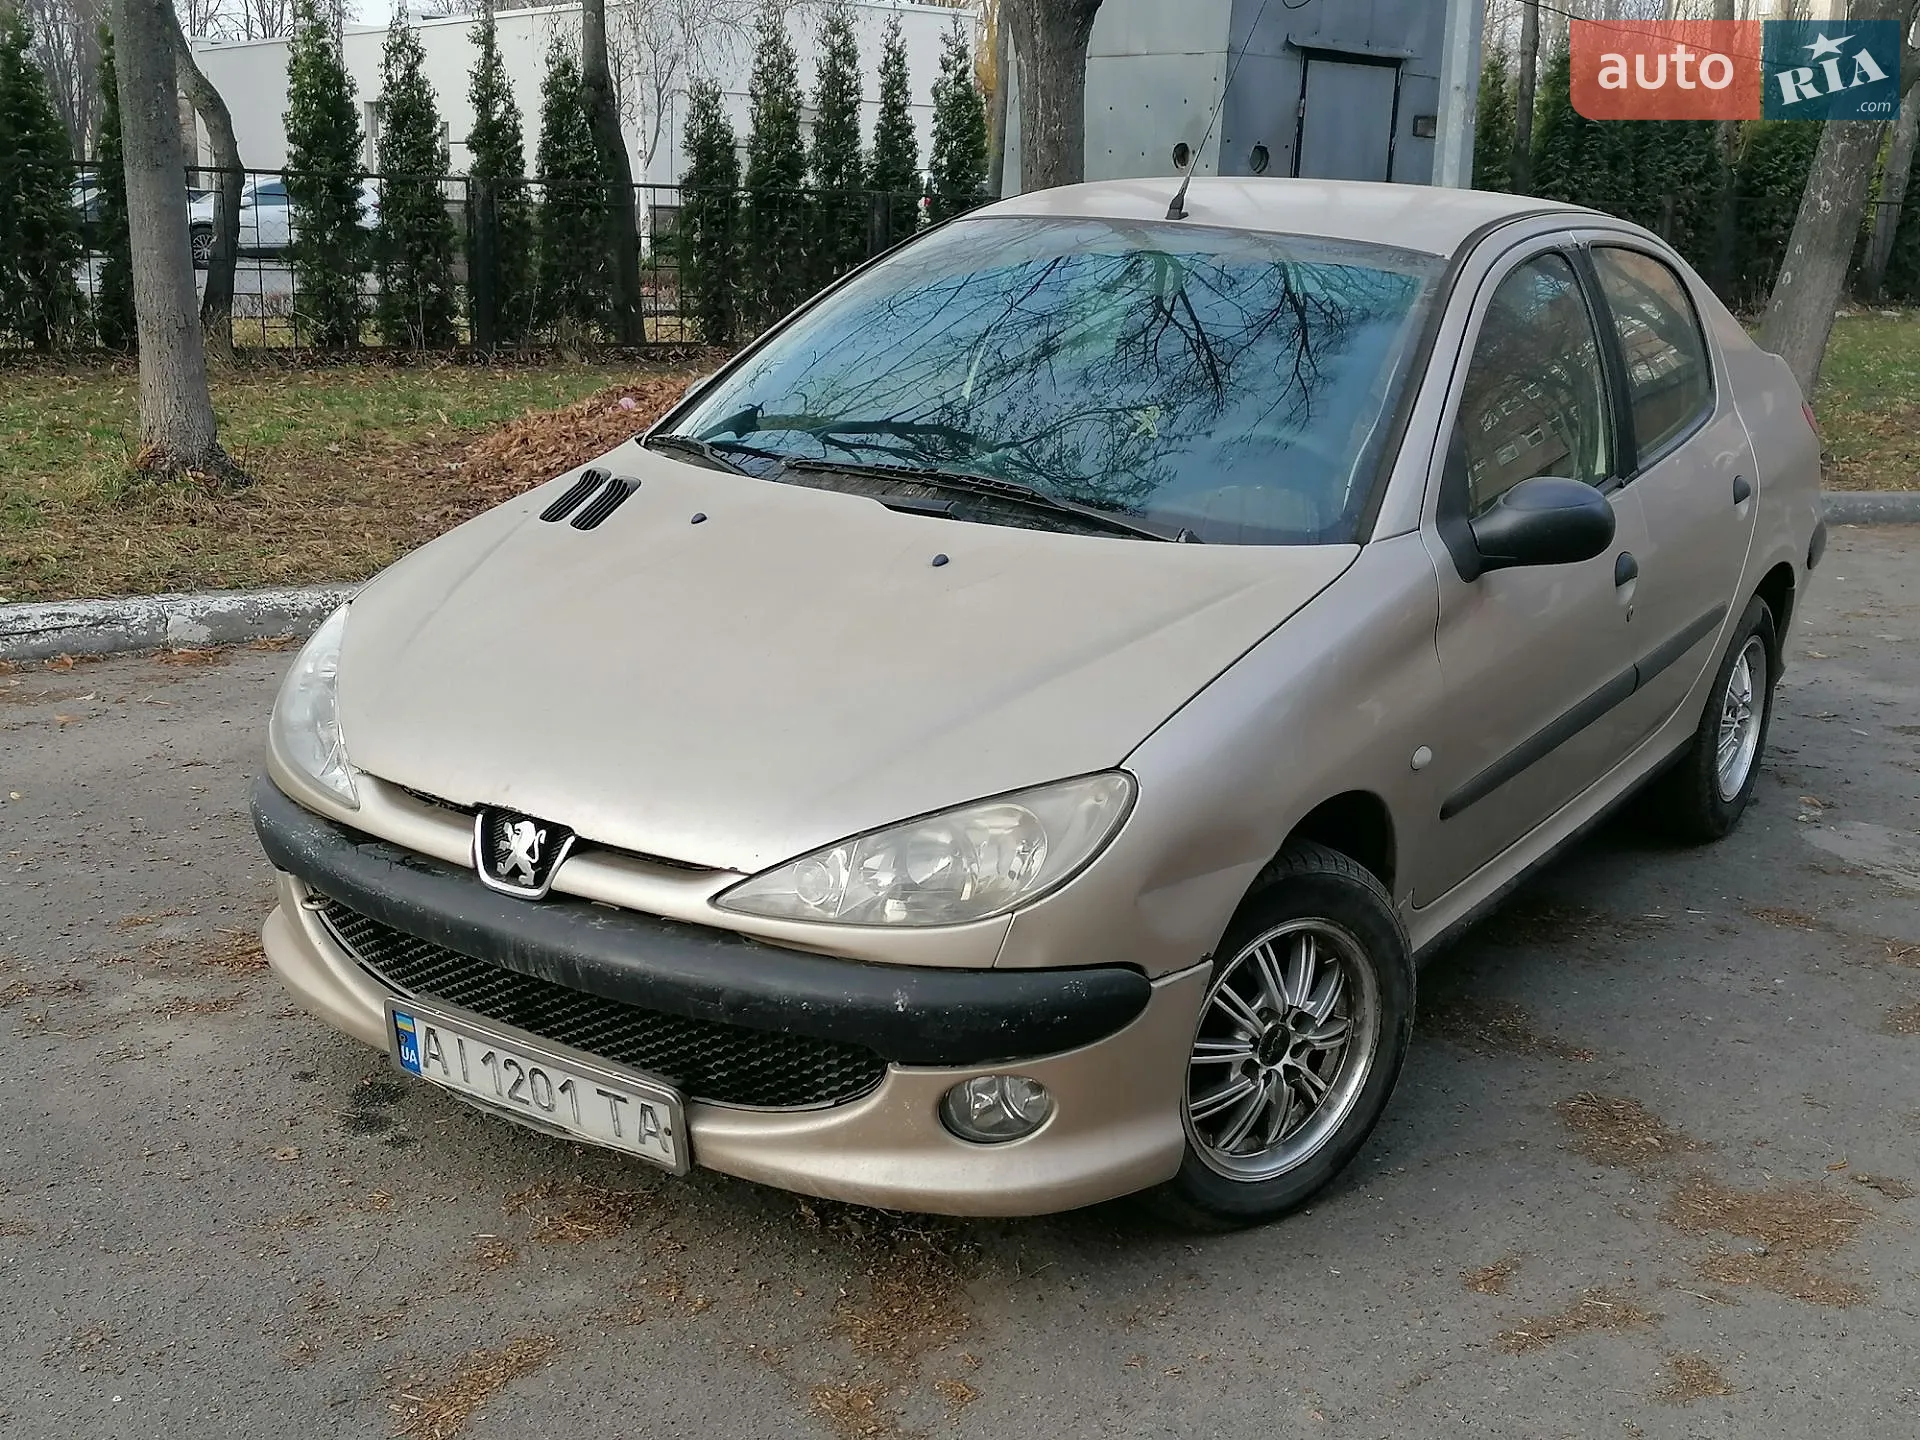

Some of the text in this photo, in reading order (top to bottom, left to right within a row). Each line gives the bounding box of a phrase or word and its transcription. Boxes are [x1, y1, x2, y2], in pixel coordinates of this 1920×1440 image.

[401, 1045, 418, 1066] UA
[423, 1026, 670, 1153] AI 1201 TA
